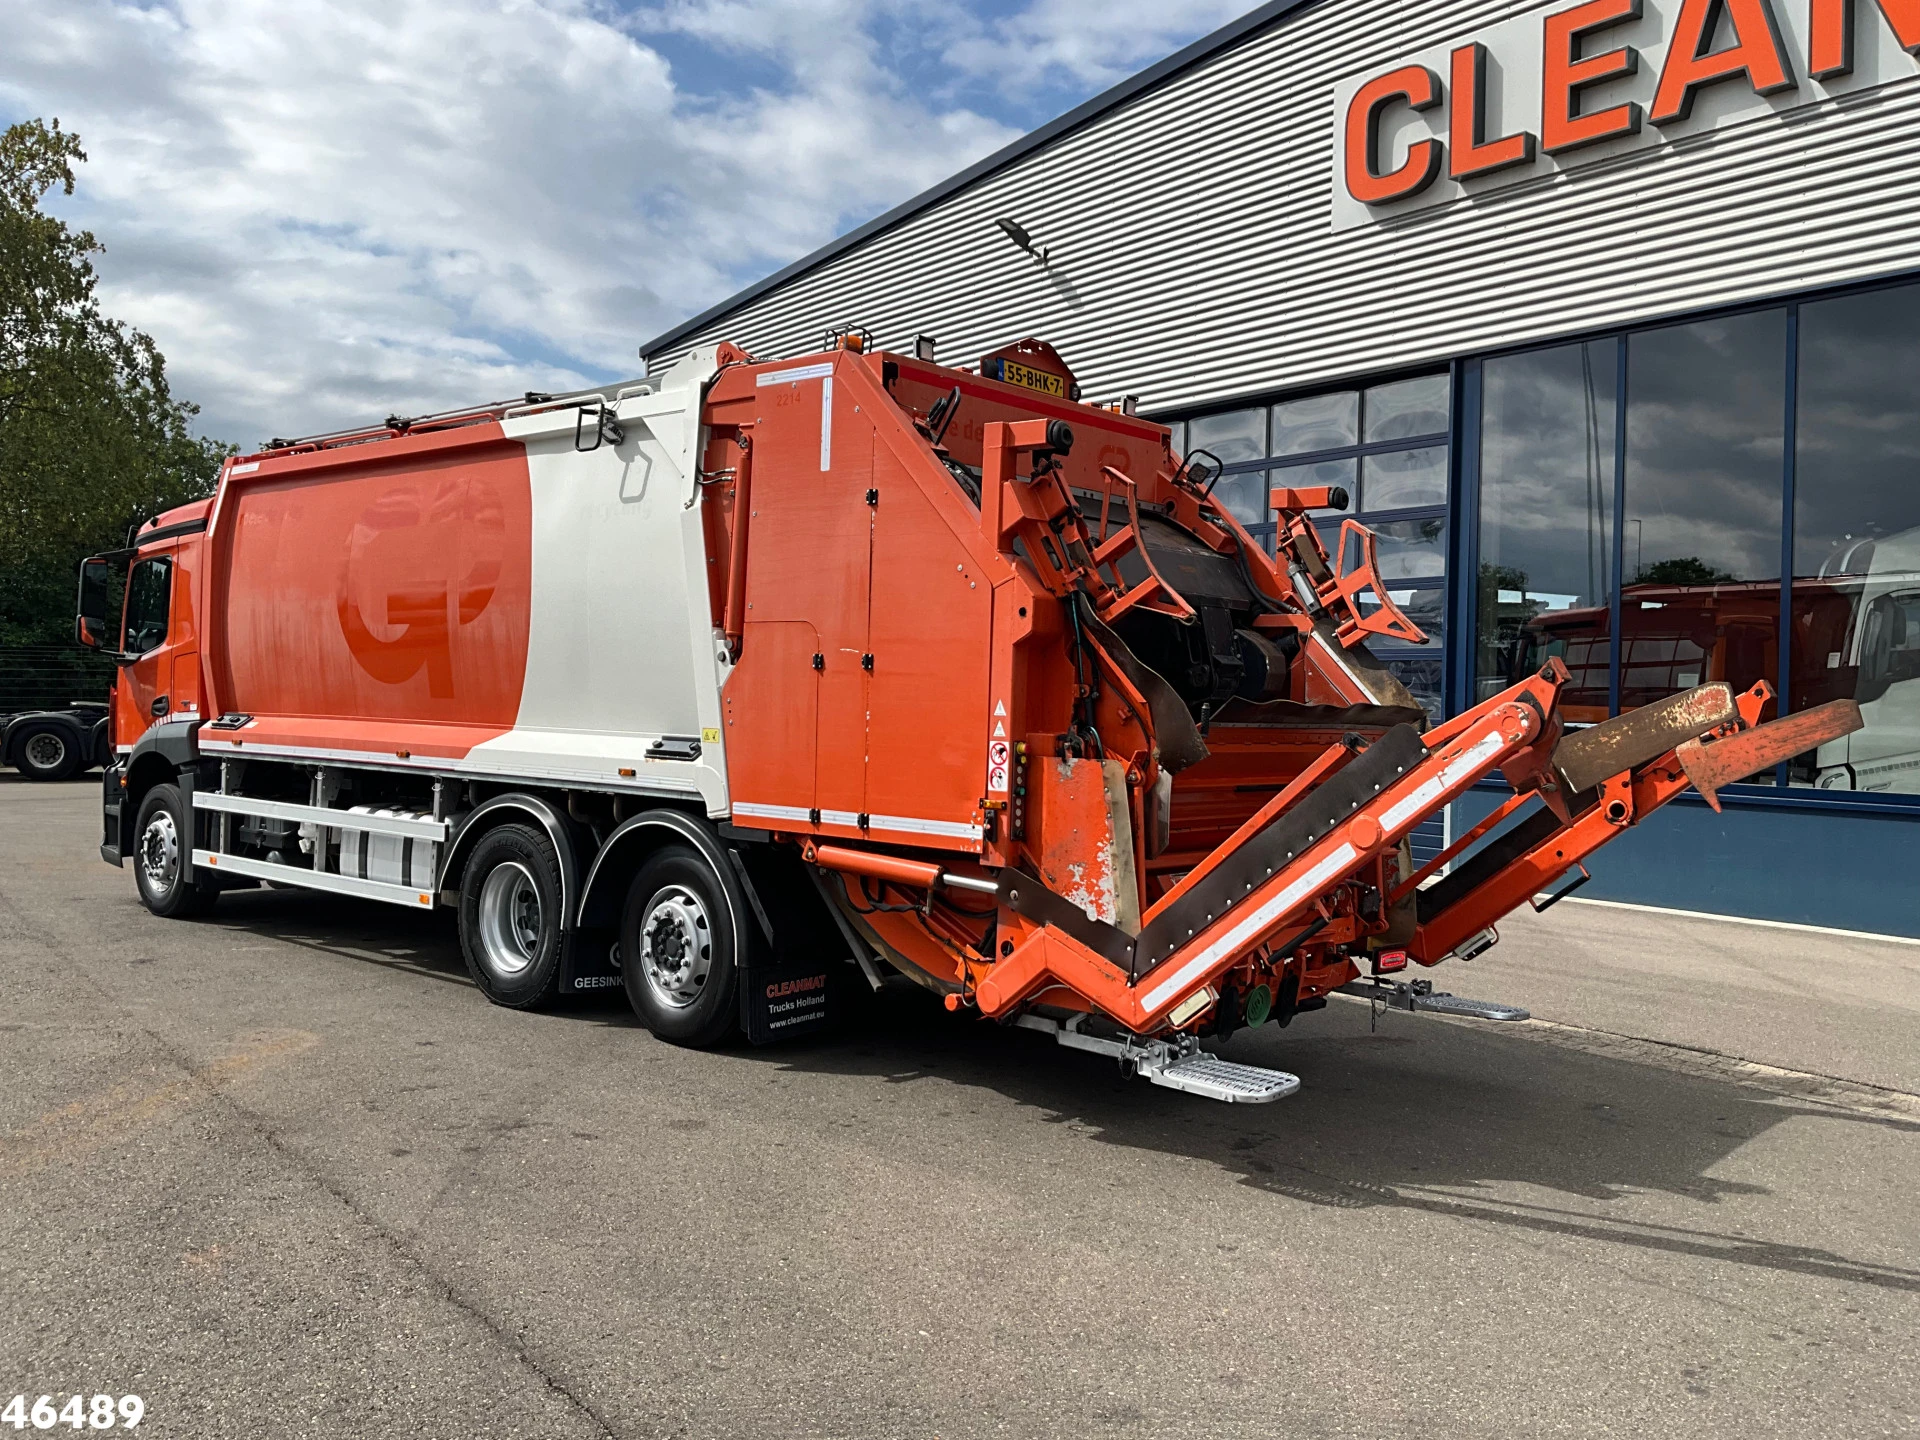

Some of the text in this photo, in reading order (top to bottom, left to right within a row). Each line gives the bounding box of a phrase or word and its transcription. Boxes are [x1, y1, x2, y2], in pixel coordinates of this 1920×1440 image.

[1007, 364, 1060, 394] 55-BHK-7
[776, 390, 801, 407] 2214
[574, 976, 624, 989] GEESINK
[766, 974, 827, 998] CLEANMAT
[768, 994, 825, 1014] Trucks Holland
[769, 1011, 825, 1029] www.cleanmat.eu
